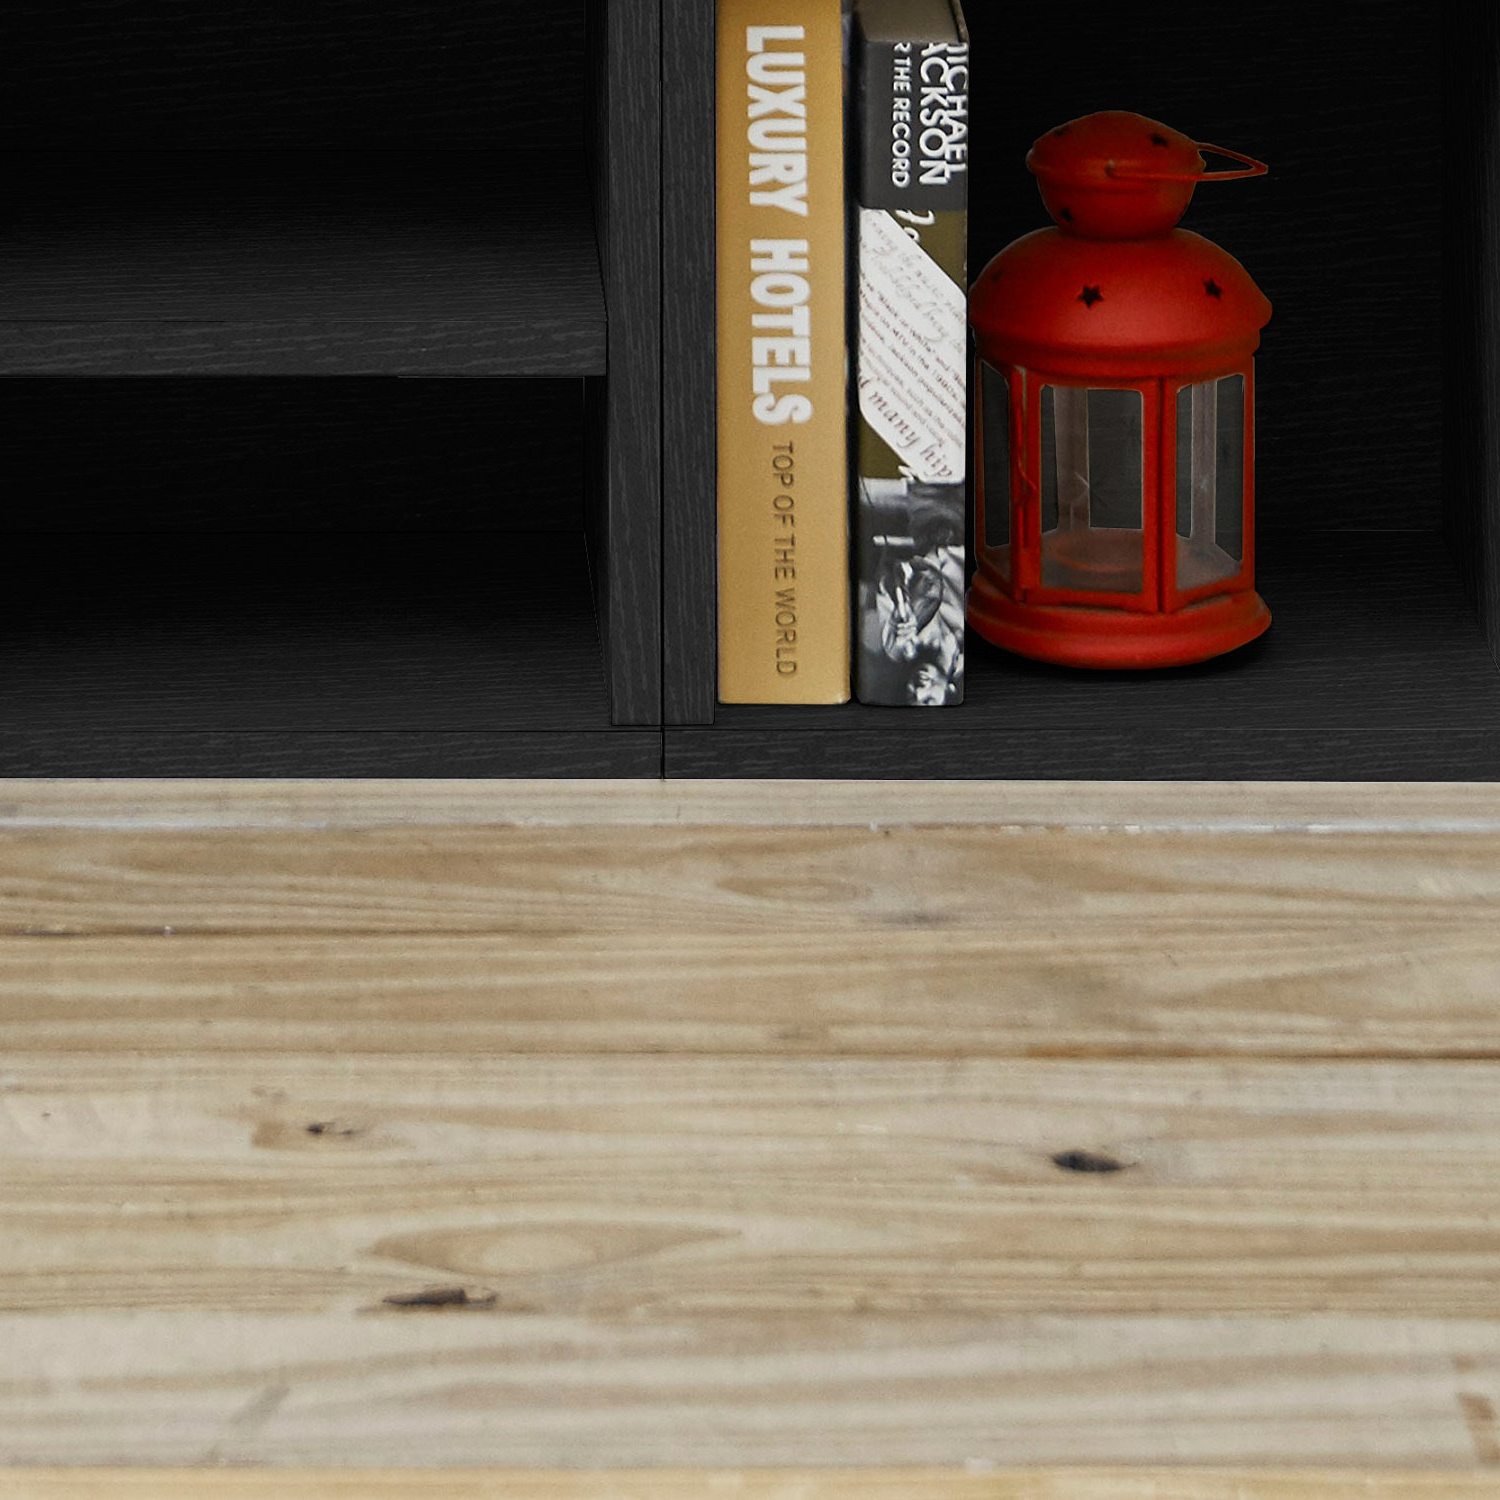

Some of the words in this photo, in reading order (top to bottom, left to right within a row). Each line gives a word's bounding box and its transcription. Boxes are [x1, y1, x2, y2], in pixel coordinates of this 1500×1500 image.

[893, 56, 912, 92] THE
[746, 25, 808, 216] LUXURY
[892, 97, 912, 189] RECORD
[750, 238, 814, 425] HOTELS
[772, 441, 795, 488] TOP
[772, 494, 796, 529] OF
[774, 533, 797, 580] THE
[774, 587, 798, 677] WORLD
